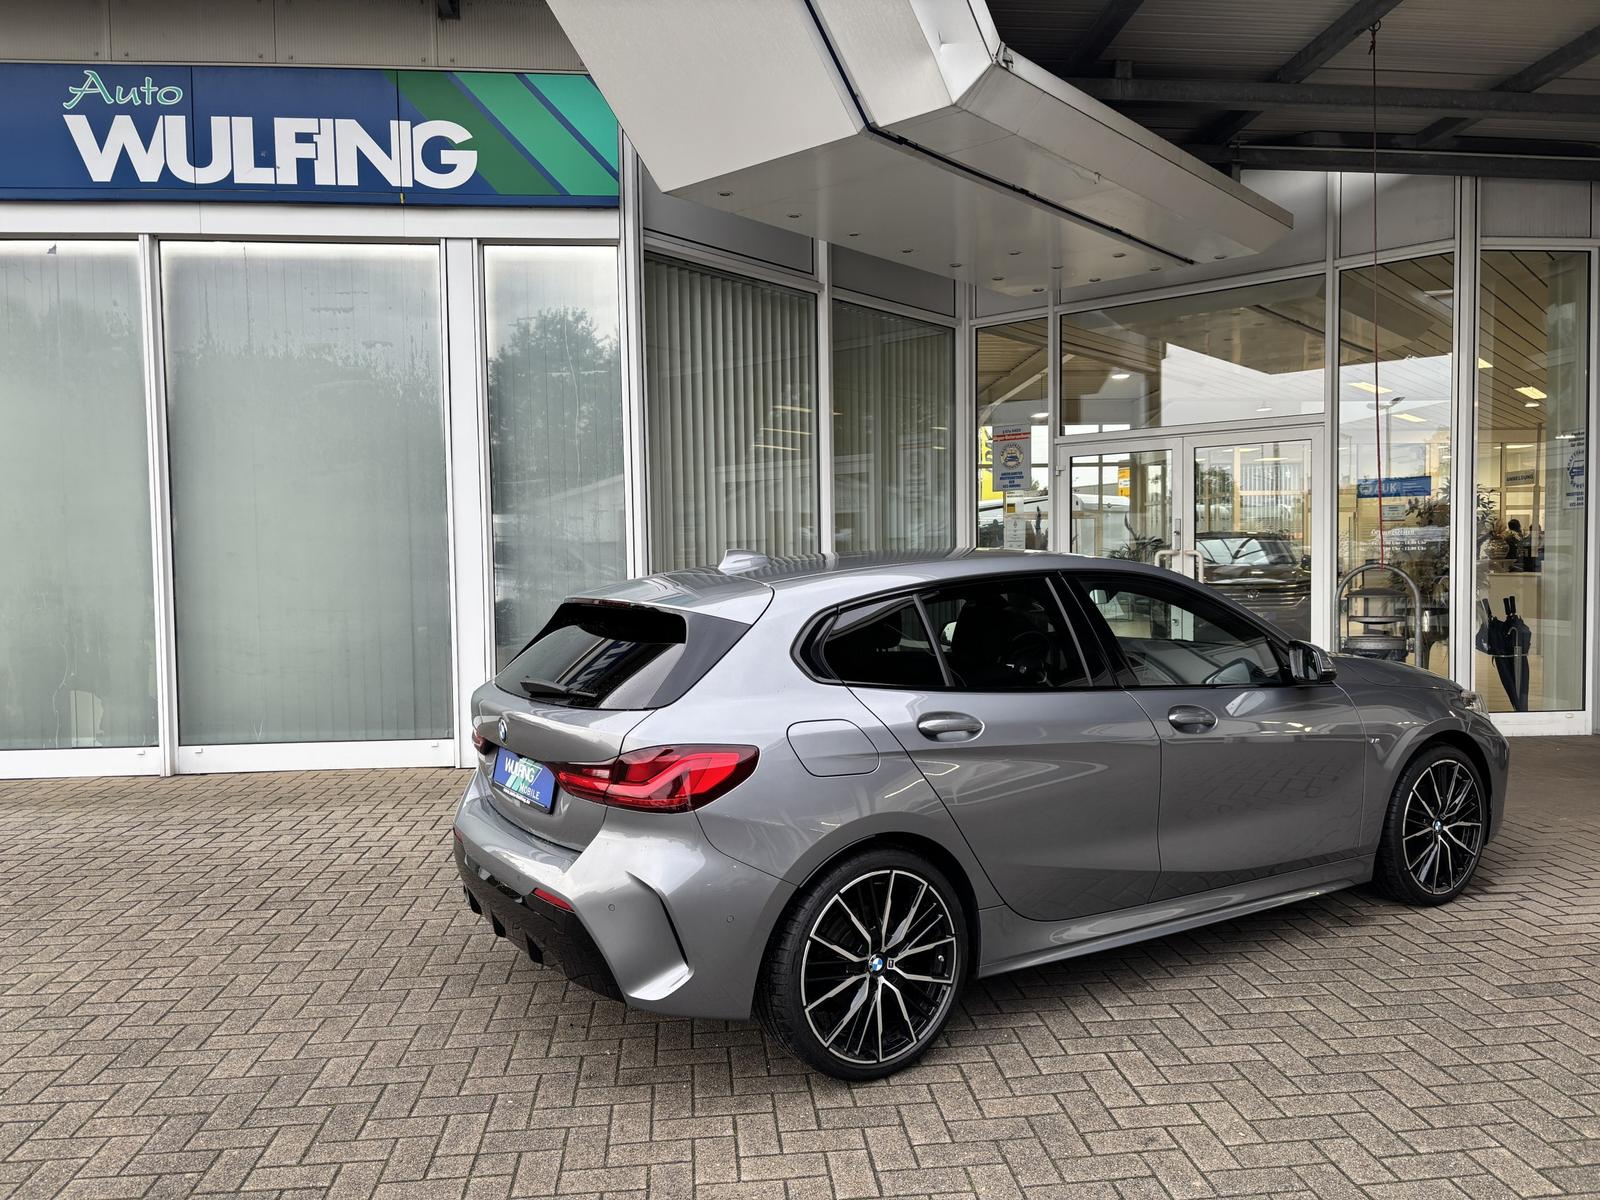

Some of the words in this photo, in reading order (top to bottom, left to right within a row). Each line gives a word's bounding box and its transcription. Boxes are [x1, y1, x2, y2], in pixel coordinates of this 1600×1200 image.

[63, 70, 183, 109] Auto
[63, 115, 478, 189] WULFING
[519, 783, 540, 800] MOBILE
